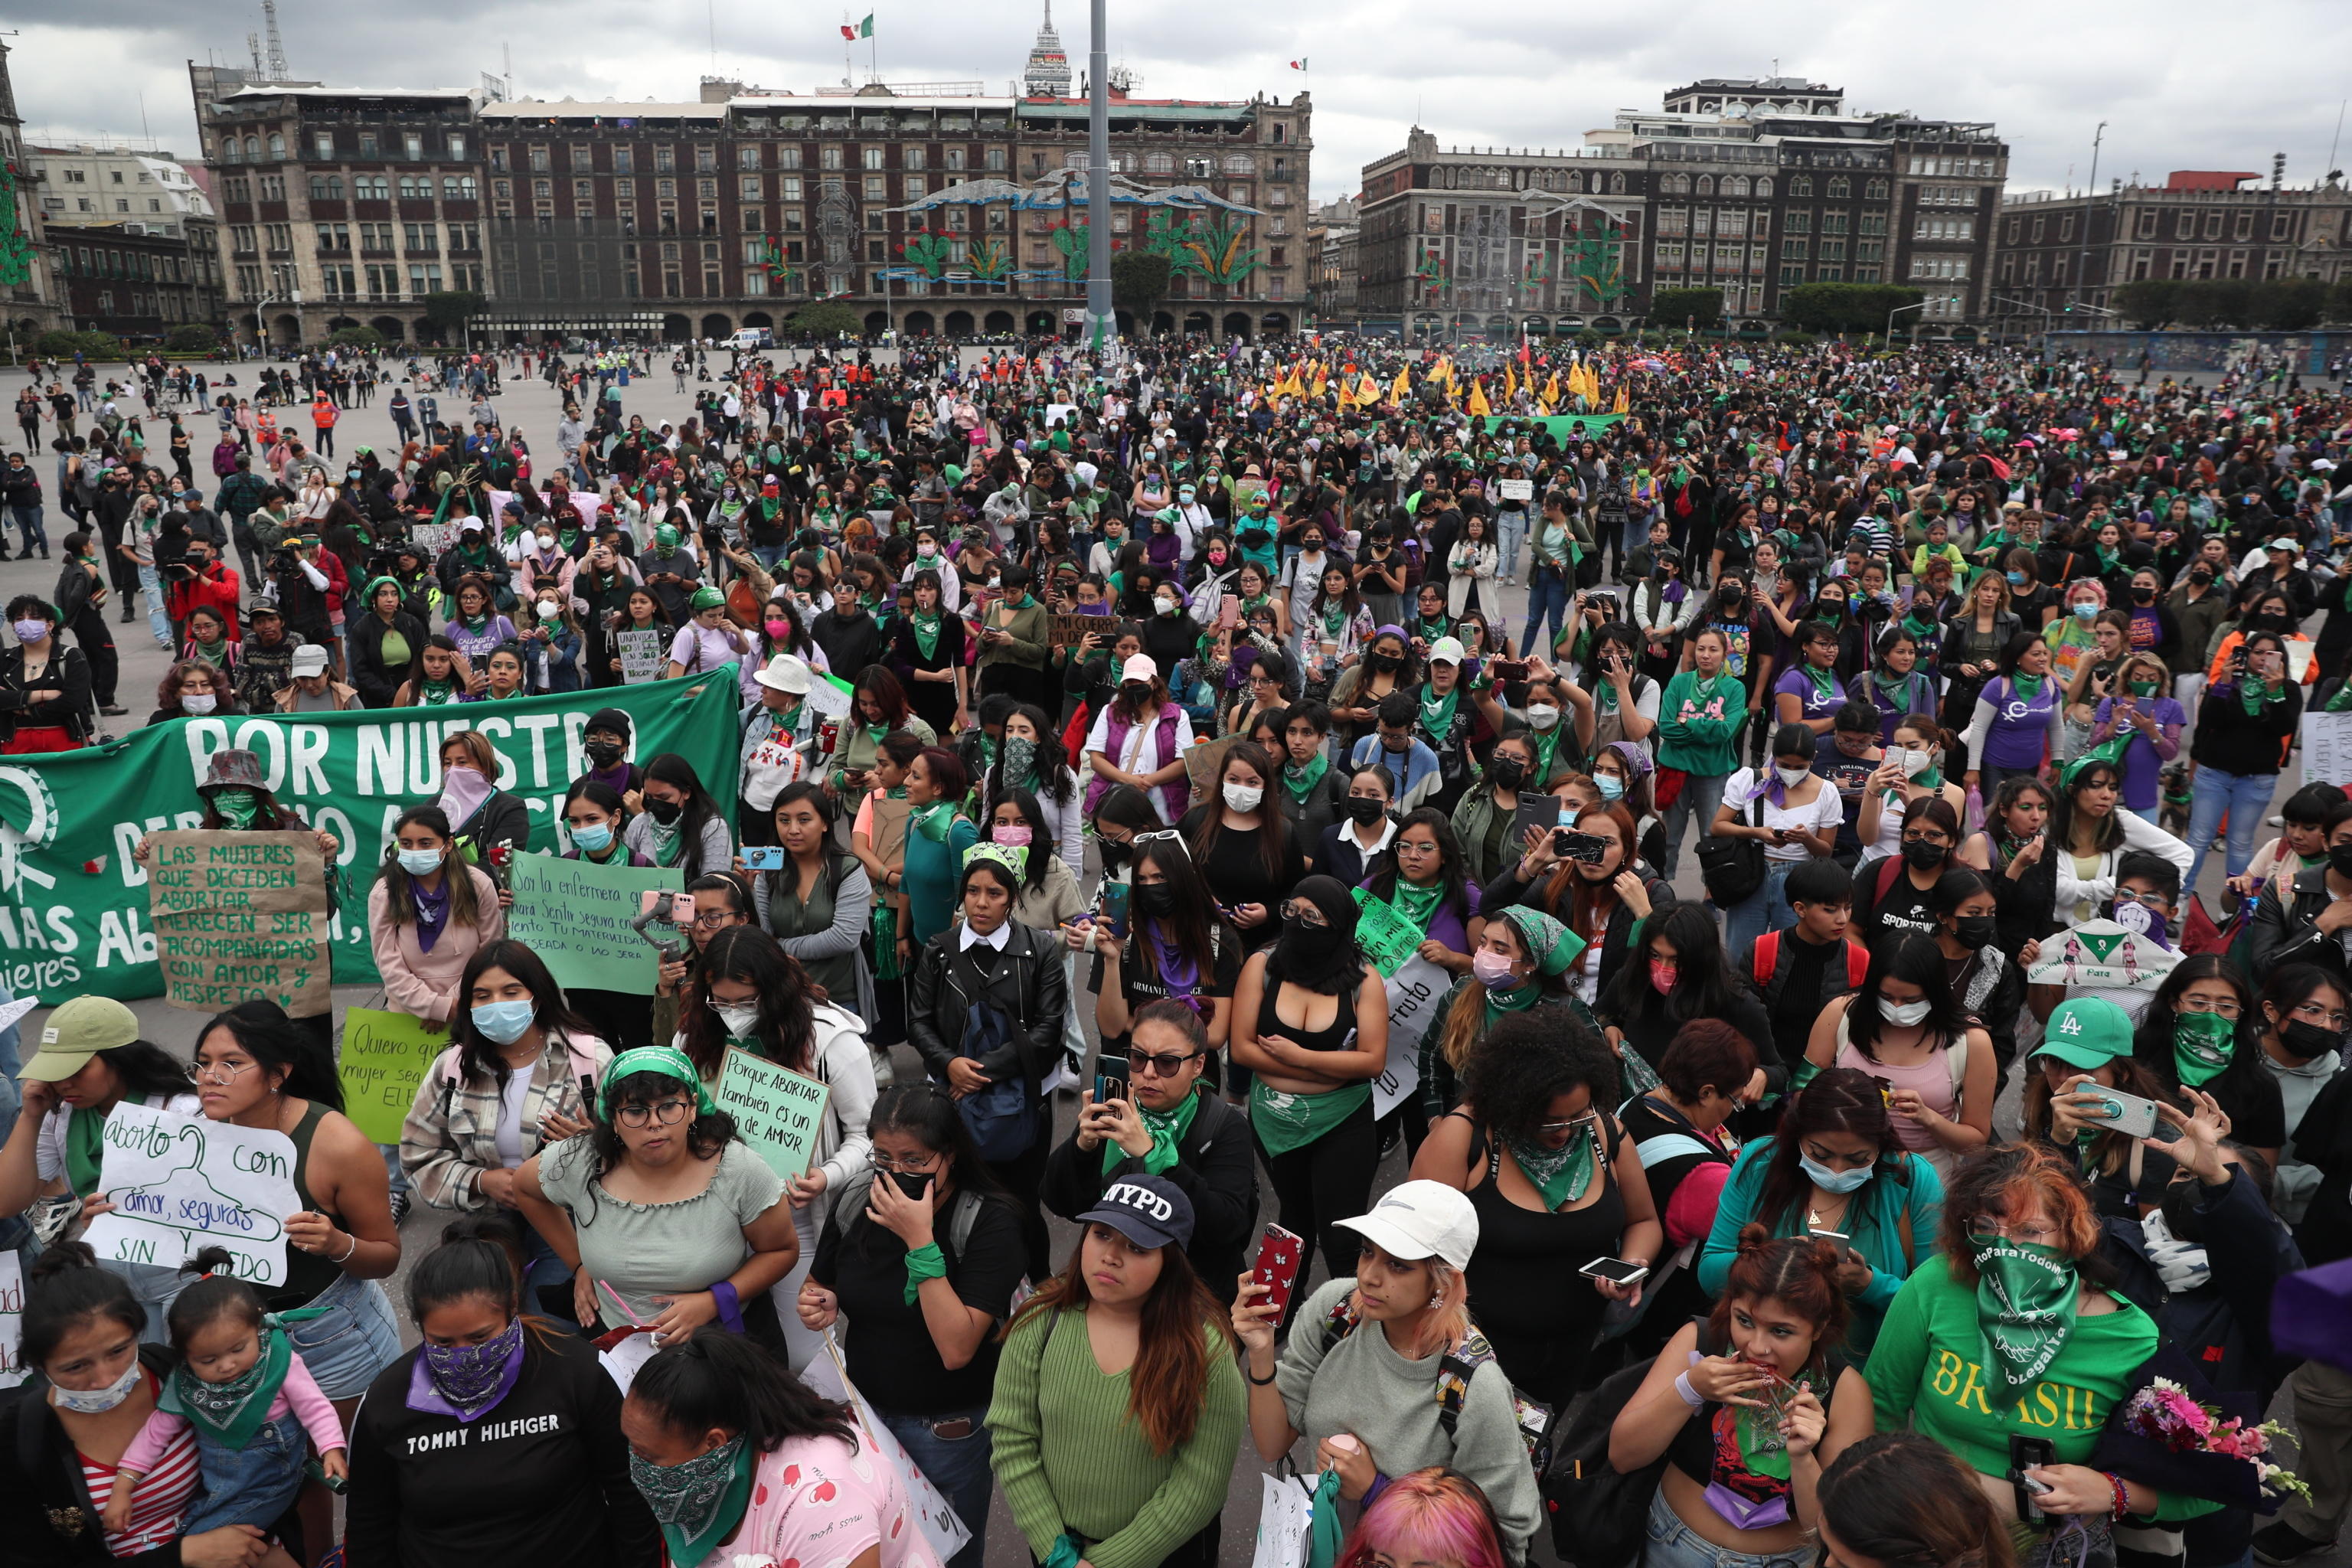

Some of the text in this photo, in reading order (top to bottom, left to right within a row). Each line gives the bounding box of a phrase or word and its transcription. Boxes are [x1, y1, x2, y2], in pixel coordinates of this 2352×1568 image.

[1057, 616, 1071, 629] MI
[621, 645, 632, 653] NO
[158, 844, 295, 867] LAS MUJERES
[155, 868, 296, 889] QUE DECIDEN
[513, 860, 535, 893] Soy
[540, 867, 551, 893] la
[559, 871, 621, 902] enfermera
[158, 890, 258, 913] ABORTAR,
[155, 912, 313, 934] MERECEN SER
[162, 936, 318, 962] ACOMPAÑADAS
[168, 961, 204, 978] CON
[214, 964, 280, 986] AMOR
[172, 981, 266, 1005] RESPETO
[2059, 1011, 2082, 1036] LA
[354, 1023, 408, 1055] Quiero
[342, 1064, 387, 1095] mujer
[727, 1053, 822, 1105] Porque ABORTAR
[721, 1080, 811, 1132] también es un
[104, 1114, 177, 1158] aborto
[744, 1114, 760, 1136] de
[124, 1191, 253, 1231] amor, seguras
[1102, 1182, 1173, 1223] NYPD
[115, 1237, 156, 1264] SIN
[178, 1230, 191, 1254] Y
[407, 1413, 560, 1455] TOMMY HILFIGER
[808, 1521, 835, 1542] you
